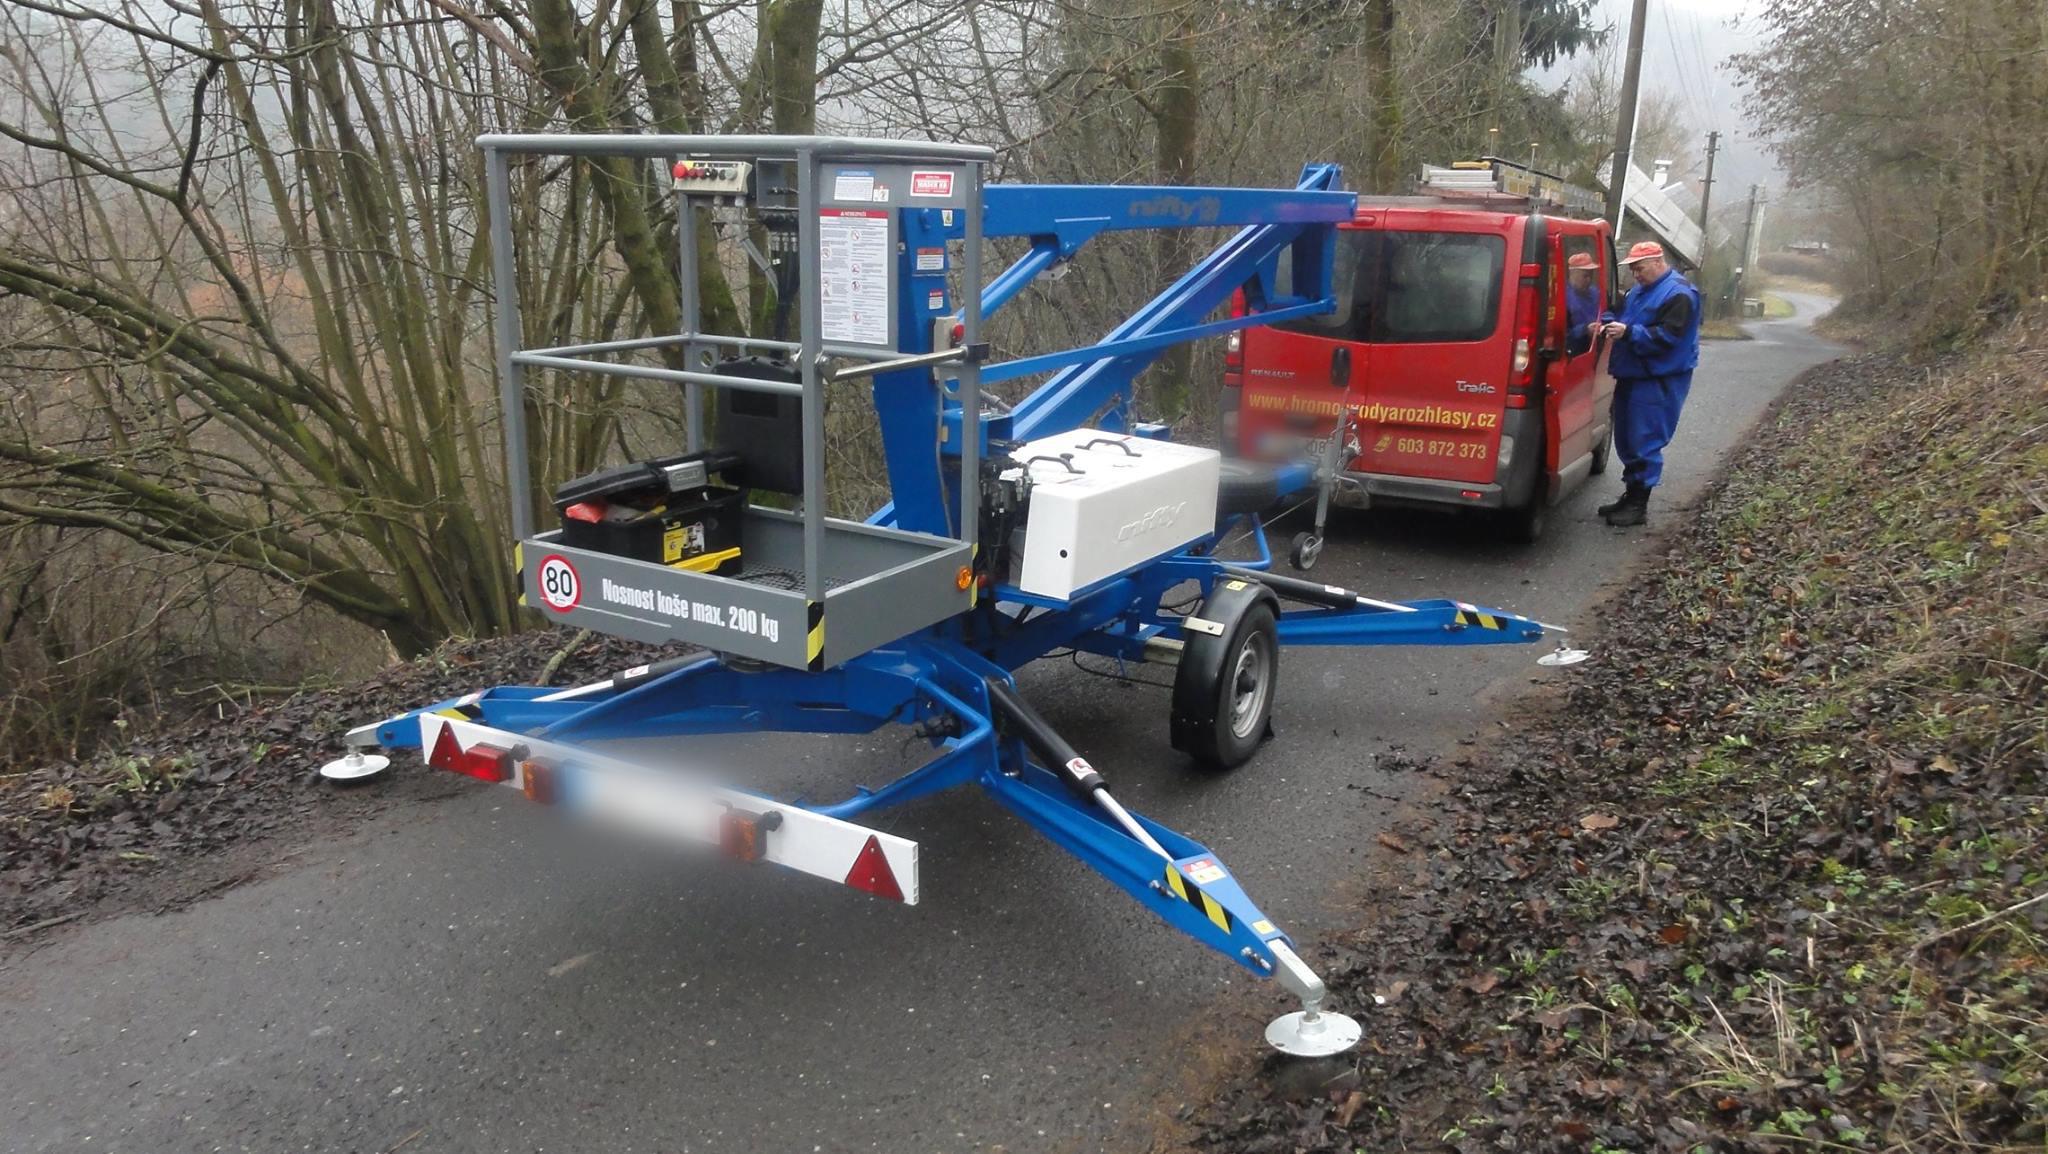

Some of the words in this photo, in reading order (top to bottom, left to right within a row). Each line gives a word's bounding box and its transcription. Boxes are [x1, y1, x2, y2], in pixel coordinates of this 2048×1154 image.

[1250, 368, 1296, 379] RENAULT
[1455, 380, 1496, 394] Trafic
[1249, 394, 1497, 429] www.hromoodyarozhlasy.cz
[1398, 438, 1424, 454] 603
[1428, 440, 1455, 457] 872
[1459, 443, 1487, 460] 373
[546, 566, 572, 597] 80
[602, 578, 655, 611] Nosnost
[657, 590, 689, 618] koše
[692, 601, 726, 627] max.
[728, 605, 758, 635] 200
[761, 612, 779, 643] kg
